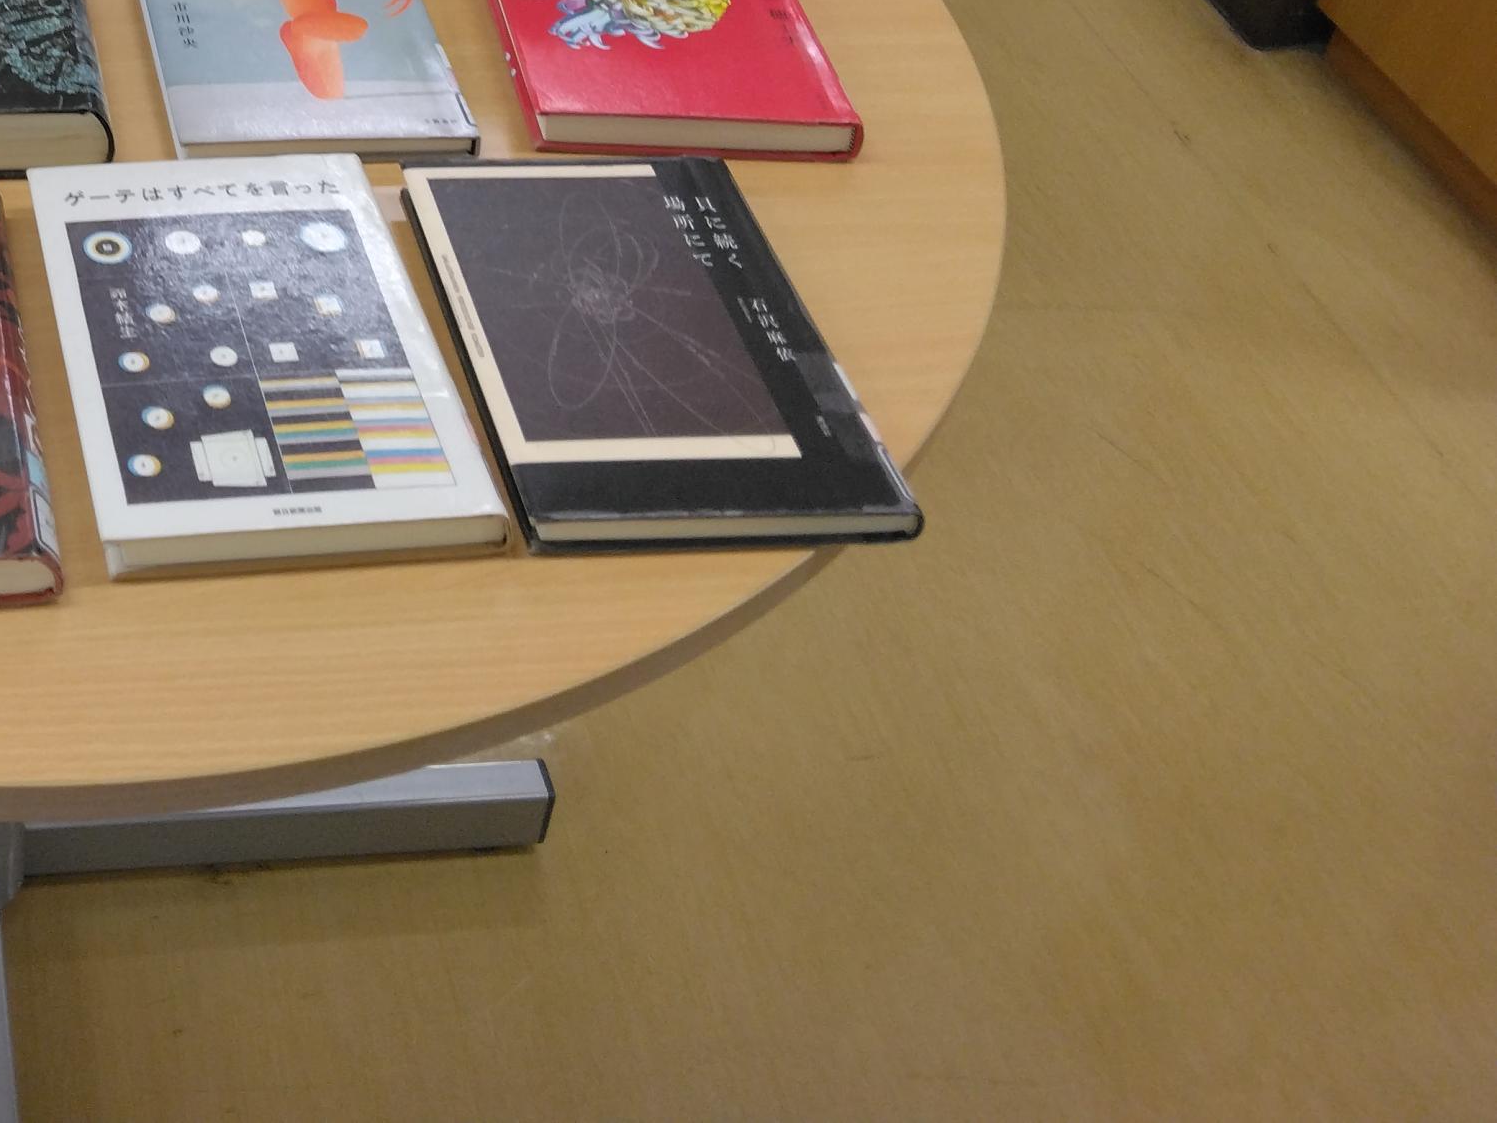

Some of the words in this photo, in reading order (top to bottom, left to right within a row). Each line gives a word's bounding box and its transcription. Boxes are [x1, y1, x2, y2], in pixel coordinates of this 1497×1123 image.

[65, 179, 341, 207] ゲーテはすべてを言った
